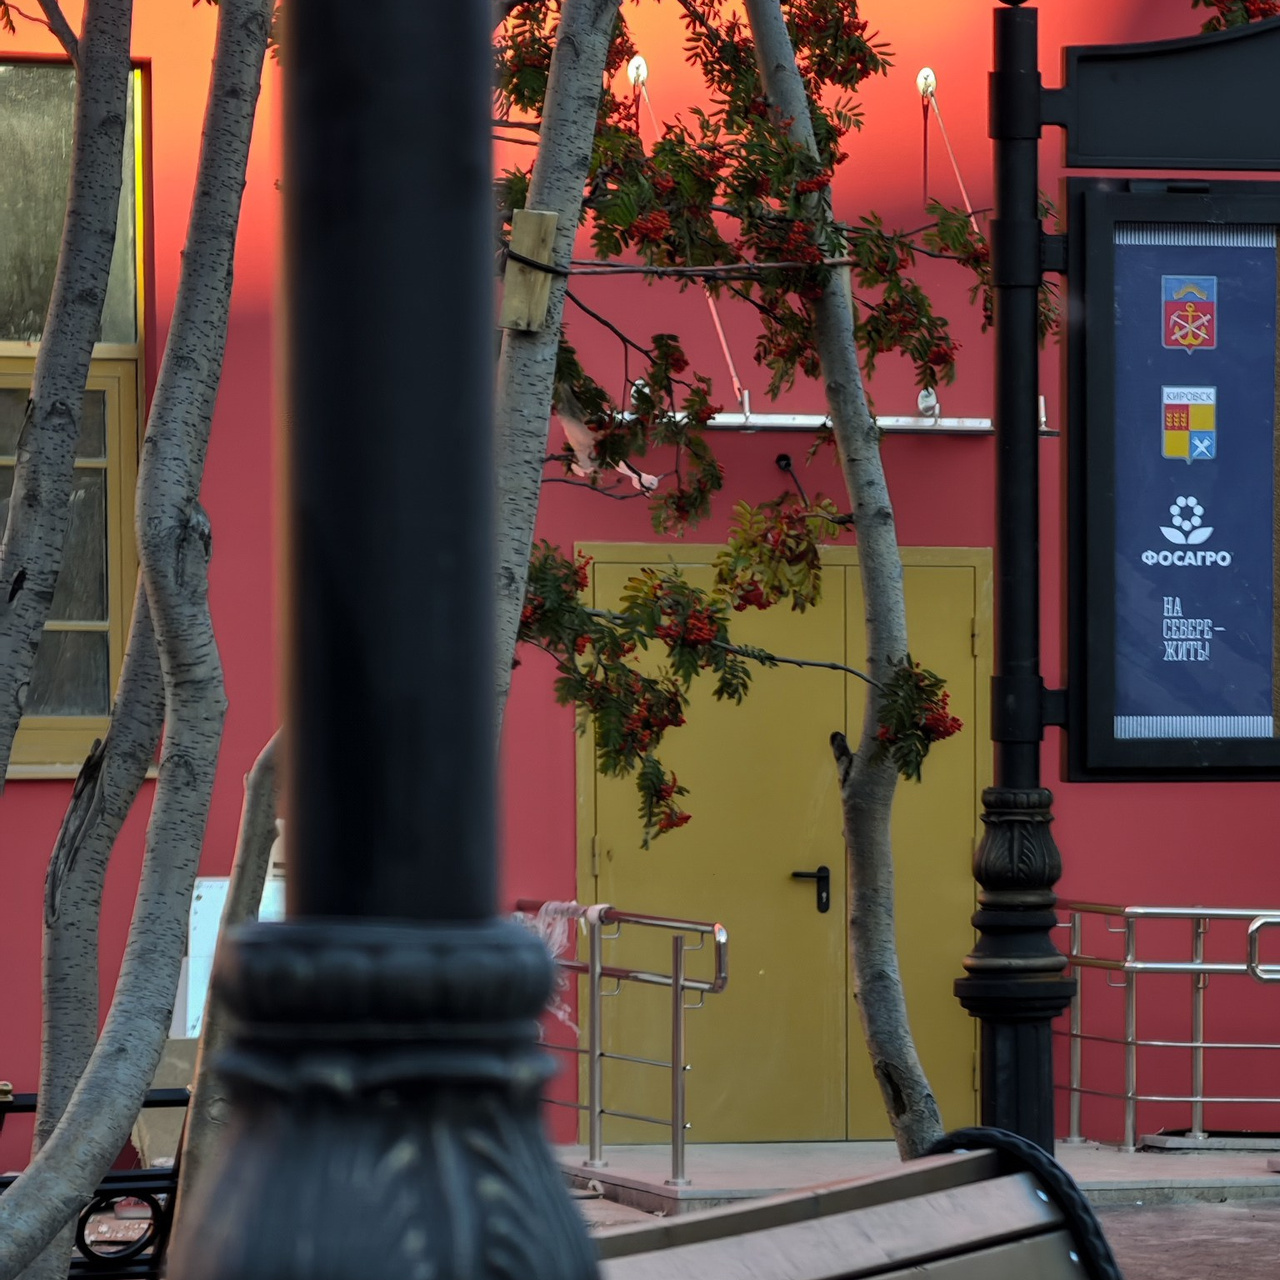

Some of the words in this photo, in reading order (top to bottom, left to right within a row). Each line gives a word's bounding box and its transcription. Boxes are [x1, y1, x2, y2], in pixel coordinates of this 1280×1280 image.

[1141, 550, 1232, 567] ФОСАГРО
[1163, 596, 1183, 617] НА
[1162, 640, 1210, 661] ЖИТЬ!
